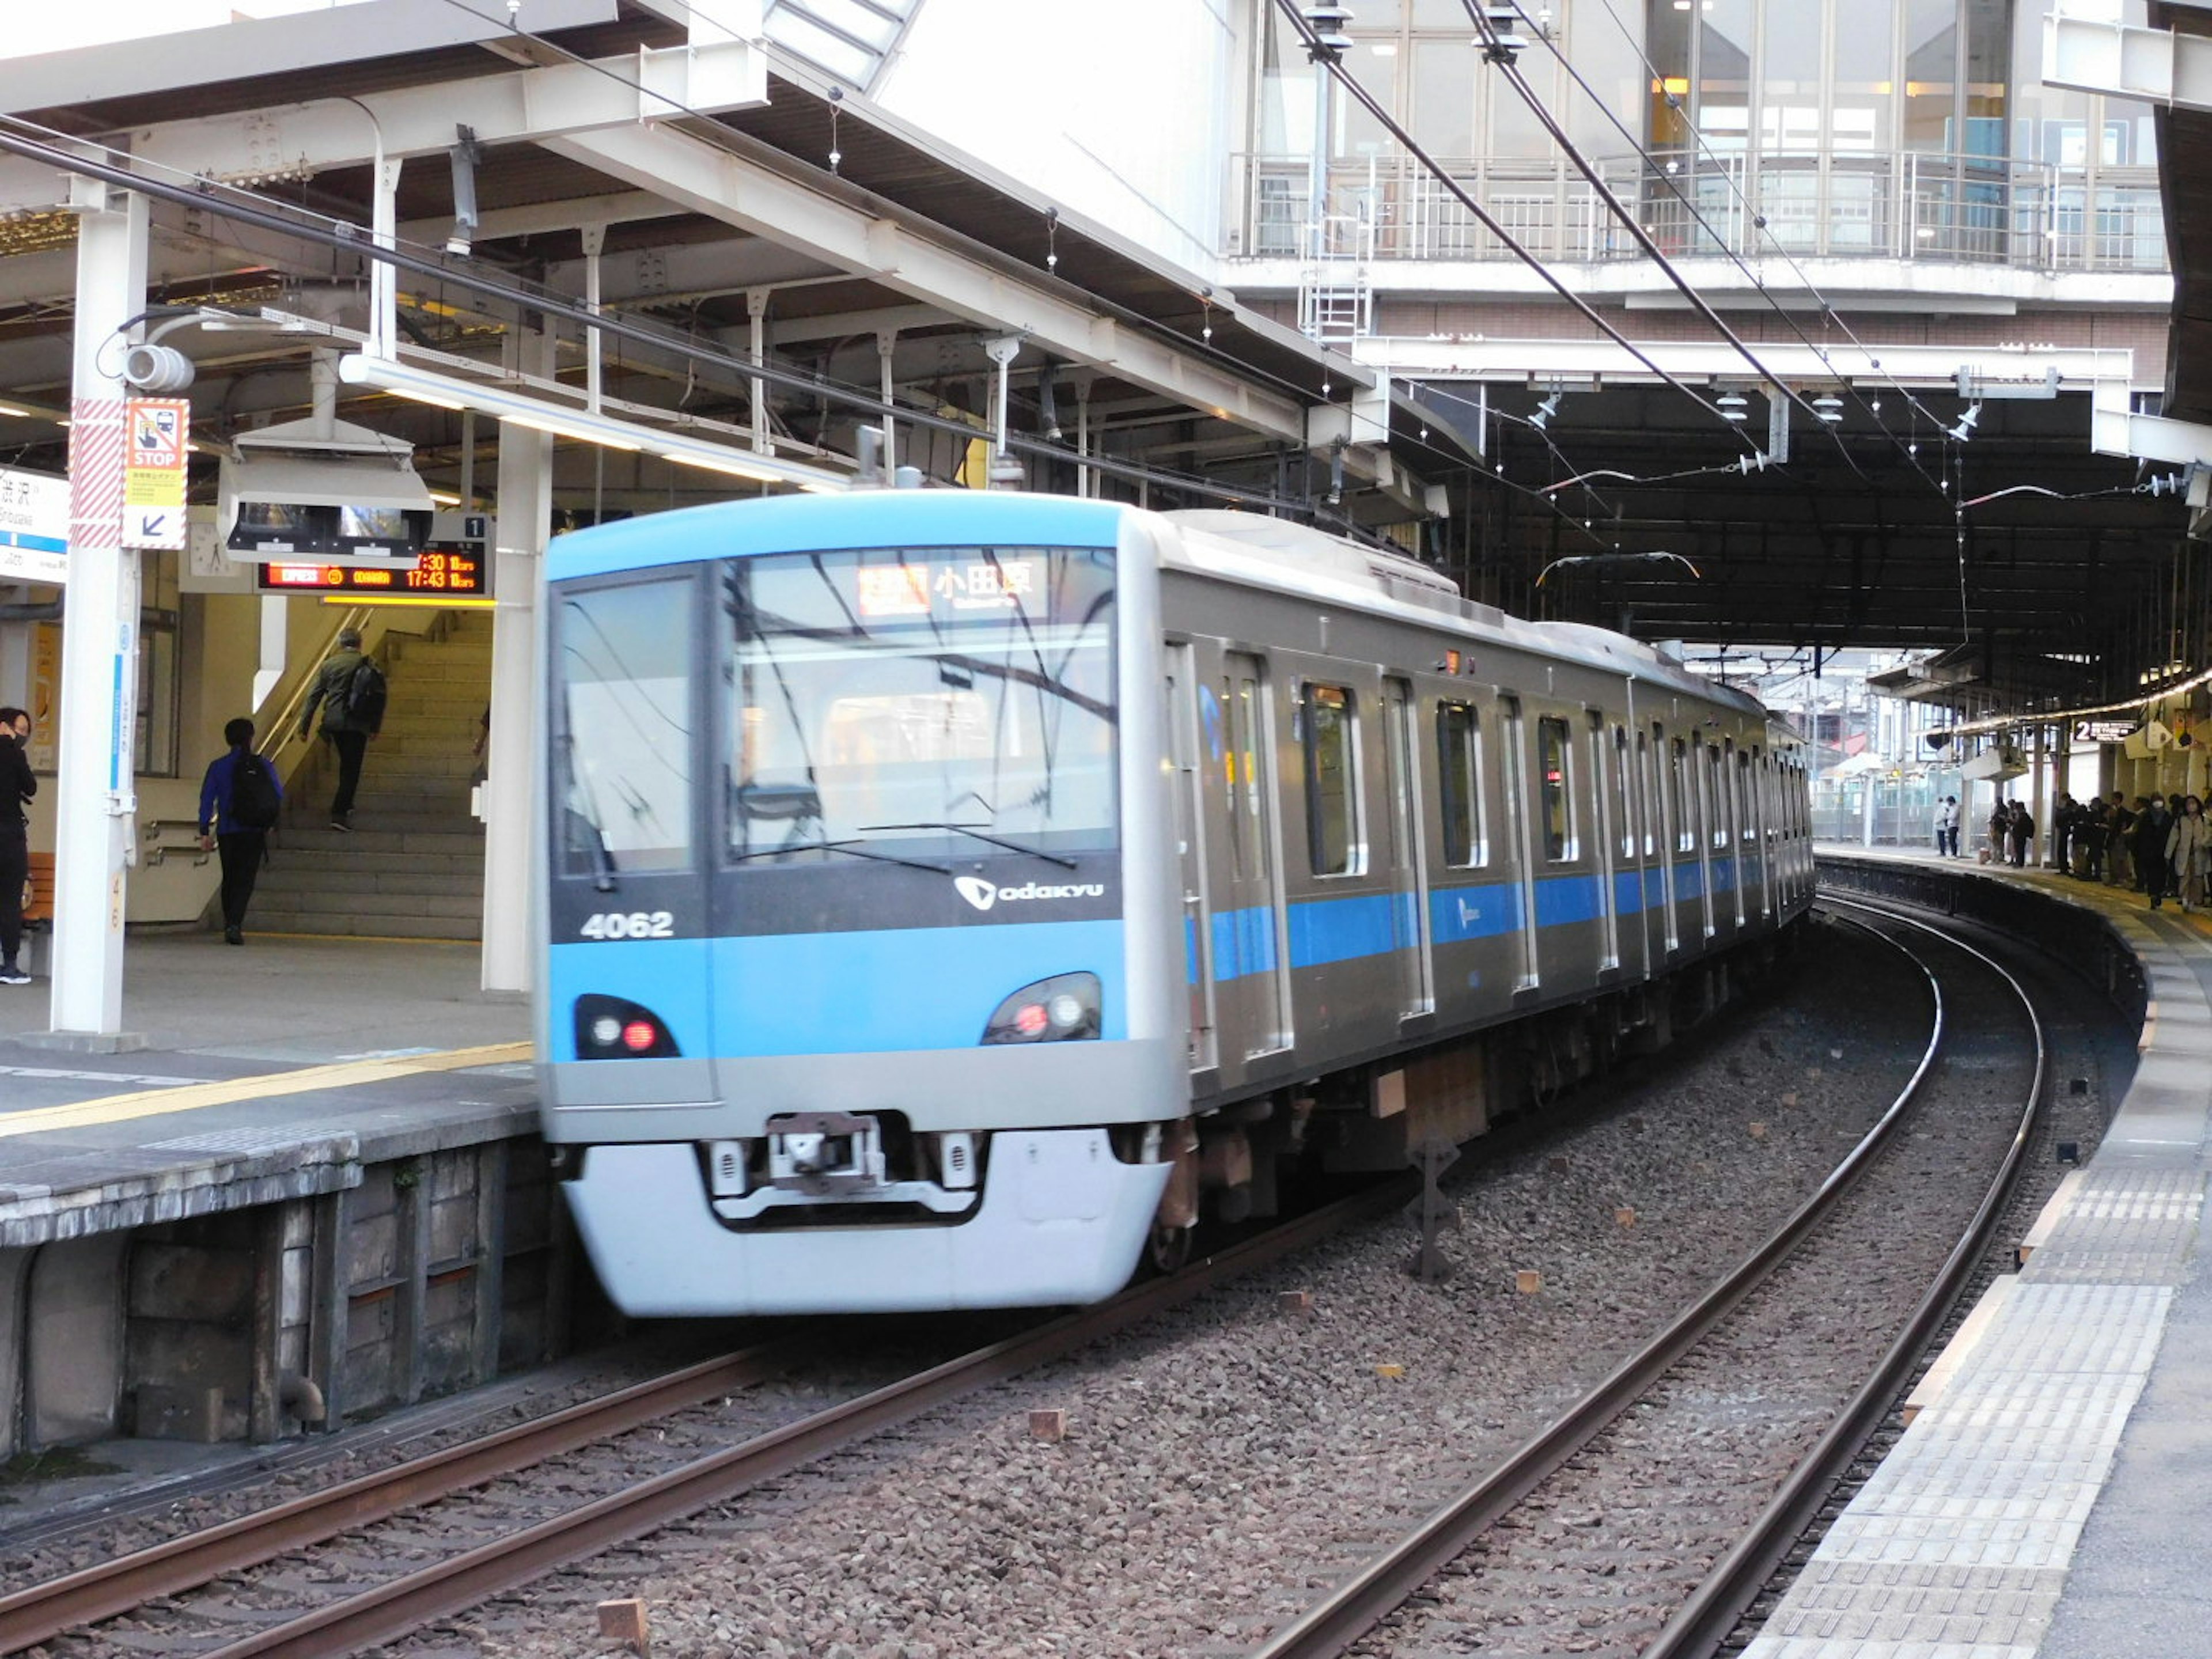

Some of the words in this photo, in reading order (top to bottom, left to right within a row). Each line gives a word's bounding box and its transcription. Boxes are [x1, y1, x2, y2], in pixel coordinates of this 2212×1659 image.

[134, 451, 176, 466] STOP
[471, 519, 479, 536] 1
[407, 570, 445, 588] 17:43
[2076, 721, 2090, 740] 2
[998, 881, 1104, 901] odakyu
[580, 911, 674, 940] 4062
